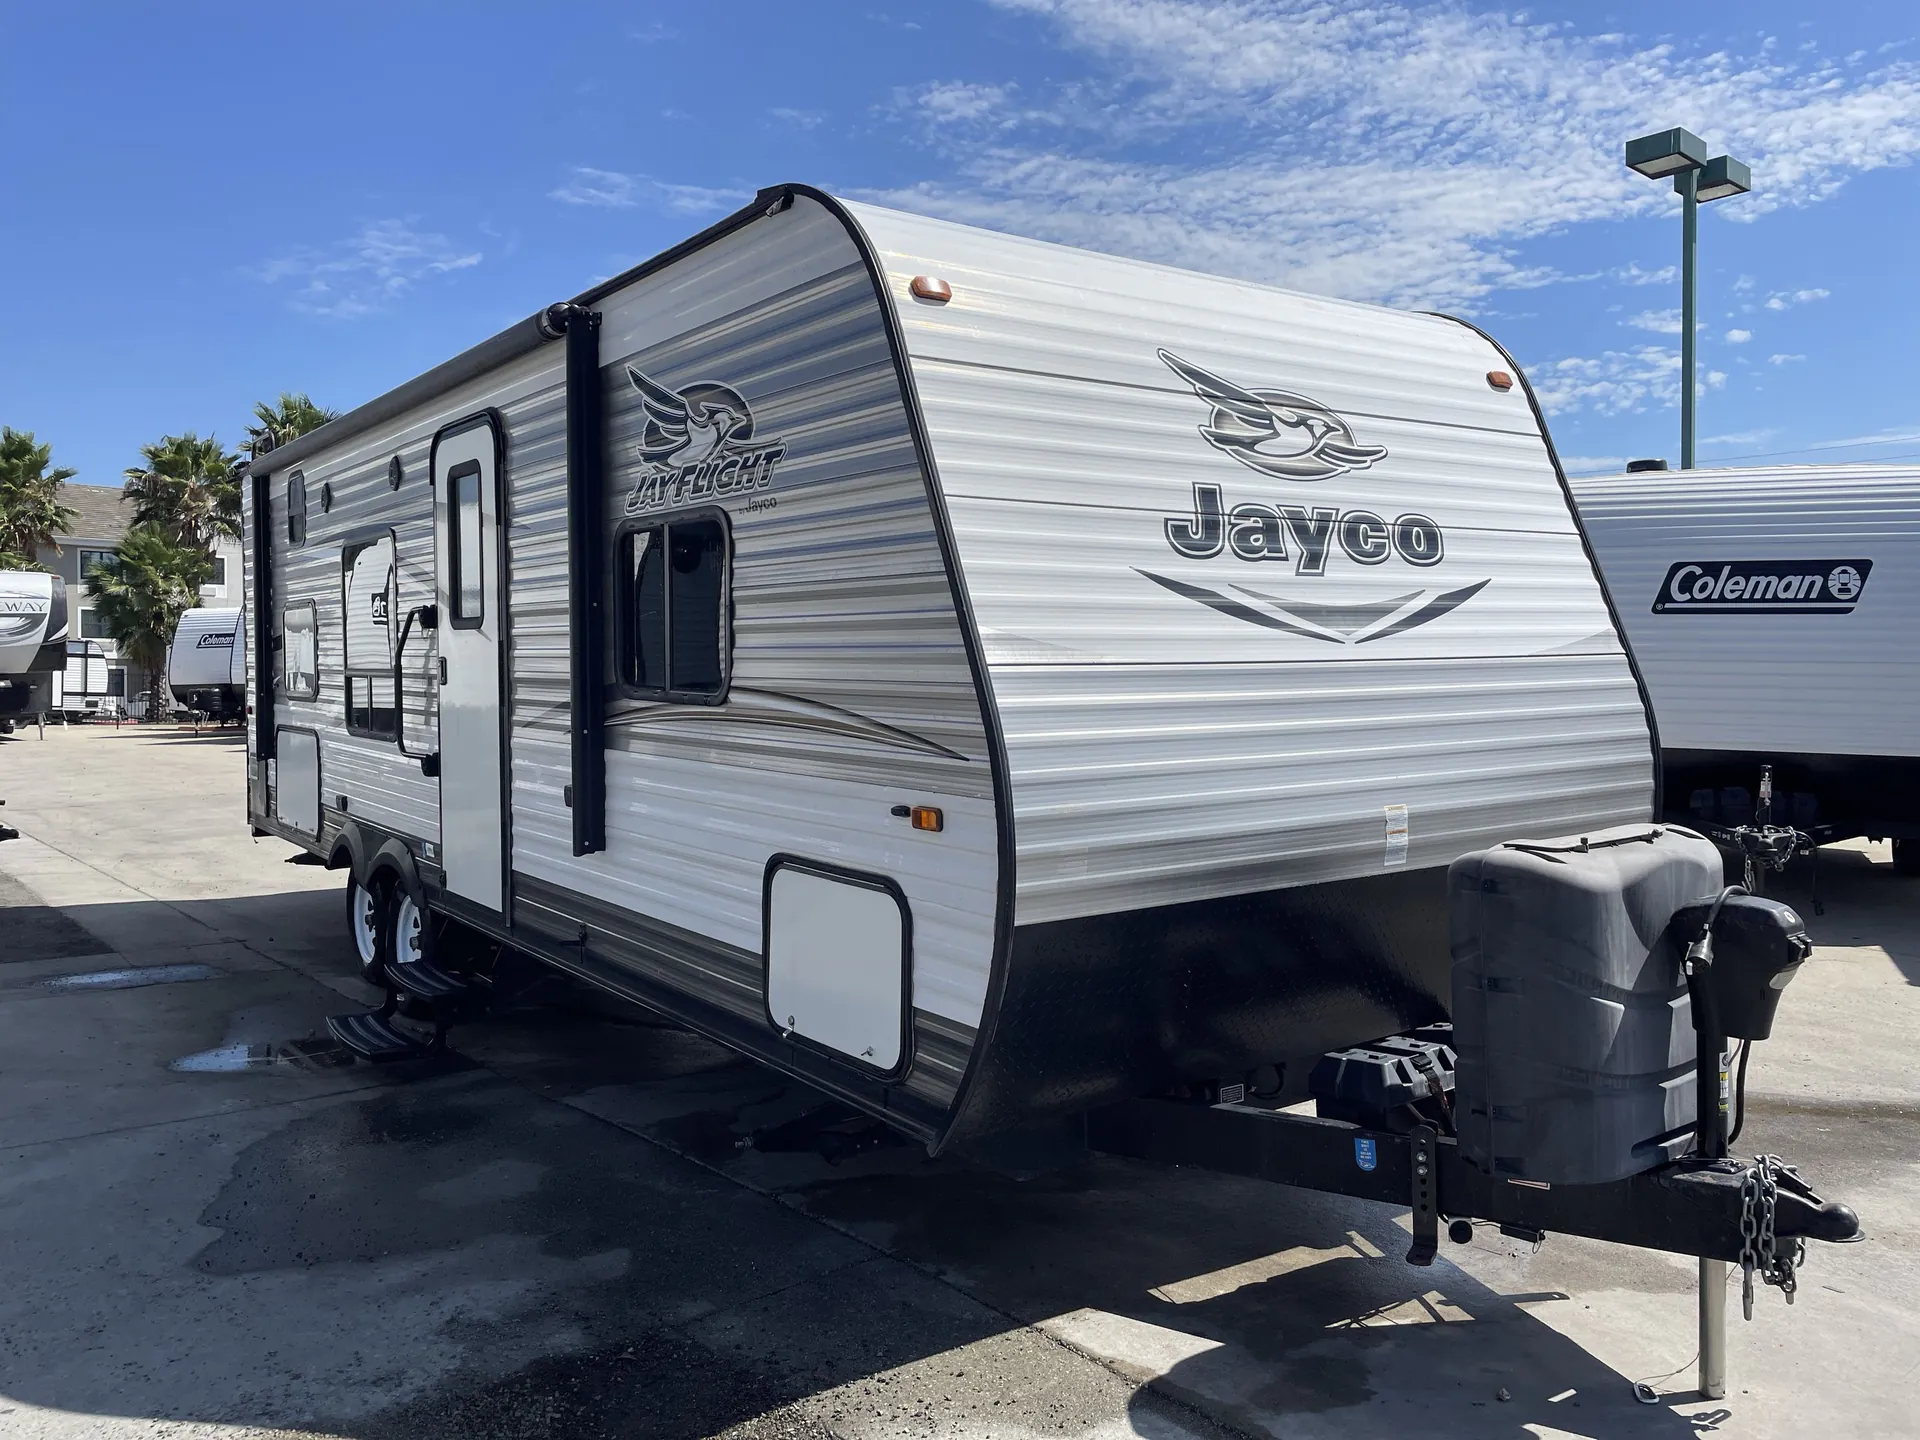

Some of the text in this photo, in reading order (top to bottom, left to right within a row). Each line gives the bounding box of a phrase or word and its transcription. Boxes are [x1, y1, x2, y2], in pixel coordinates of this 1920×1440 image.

[745, 497, 777, 514] Jayco
[1164, 481, 1445, 577] Jayco
[1670, 565, 1824, 602] Coleman
[200, 634, 234, 645] Coleman
